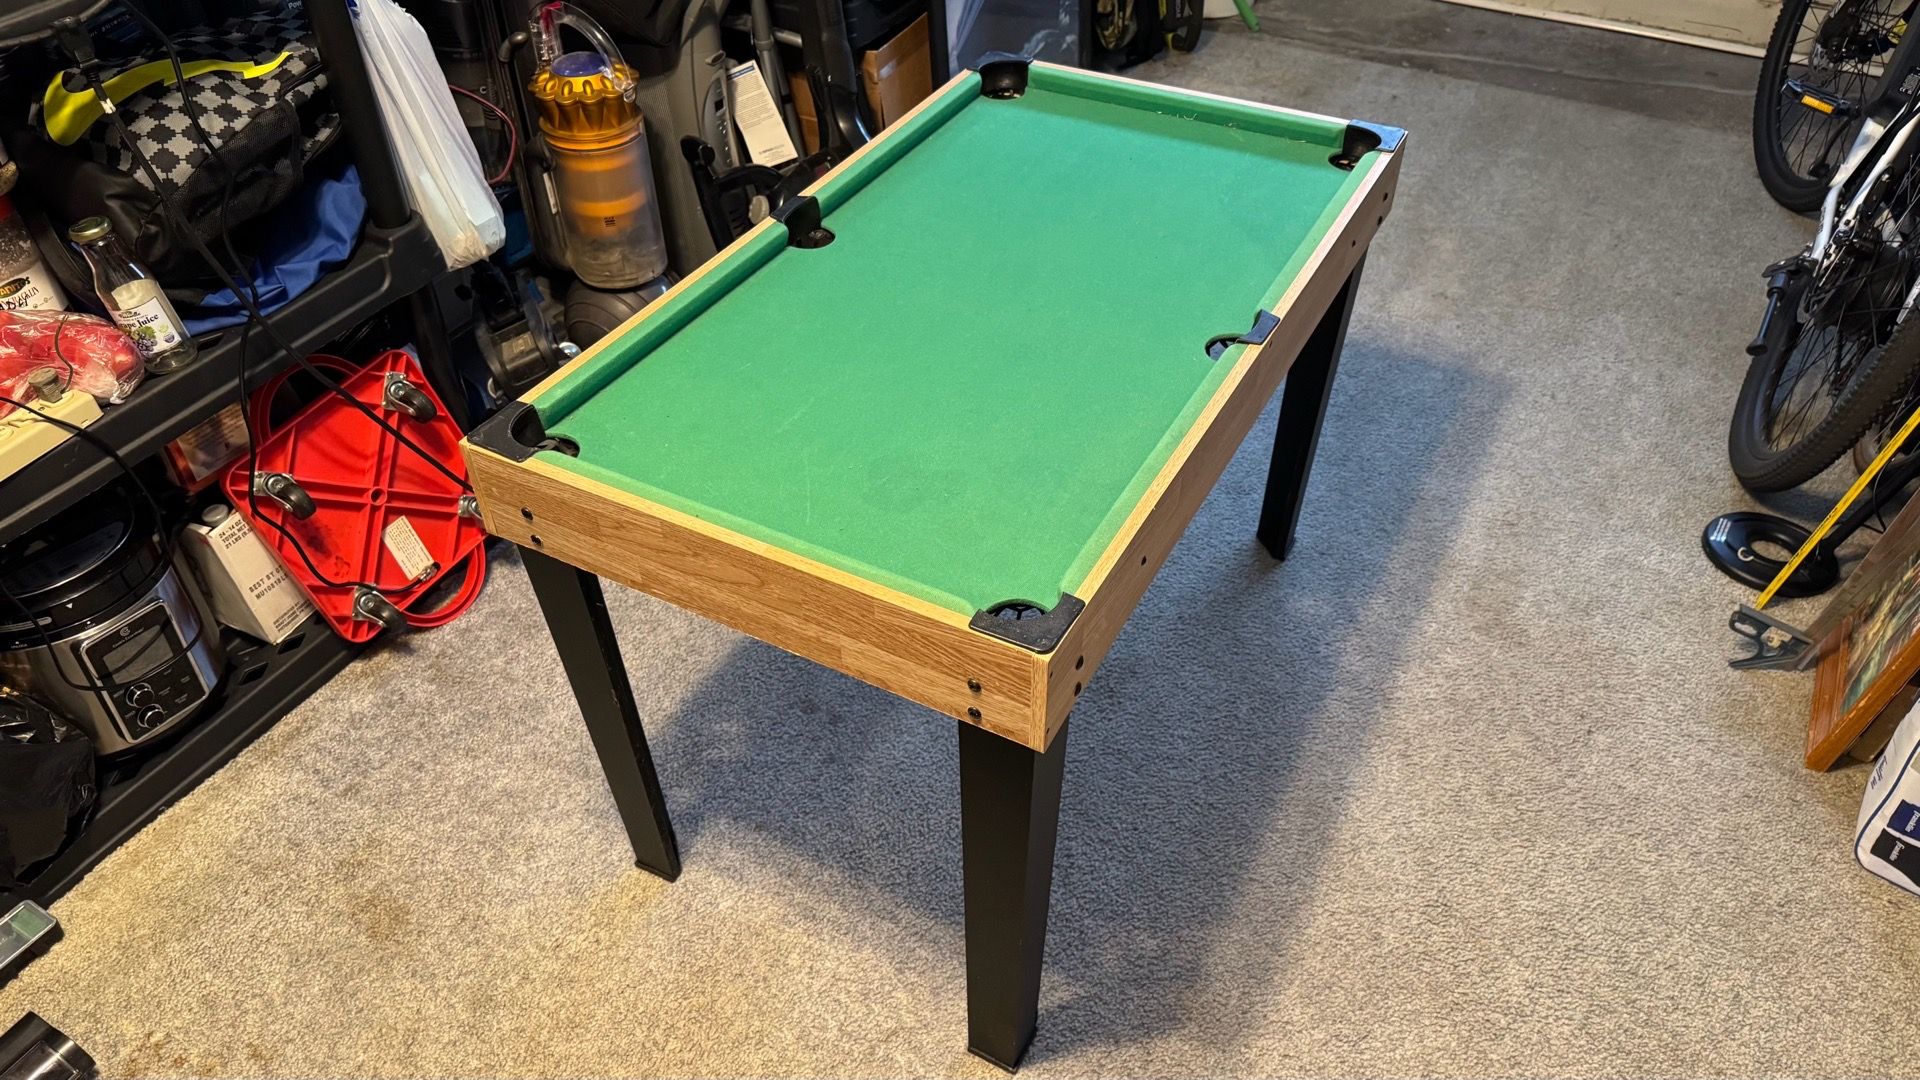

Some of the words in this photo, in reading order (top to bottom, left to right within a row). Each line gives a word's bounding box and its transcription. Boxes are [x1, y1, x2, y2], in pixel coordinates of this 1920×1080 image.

[137, 314, 159, 328] Juice
[222, 531, 237, 543] TOTAL
[232, 535, 241, 544] LBS
[249, 578, 265, 592] BEST
[265, 570, 275, 581] BY
